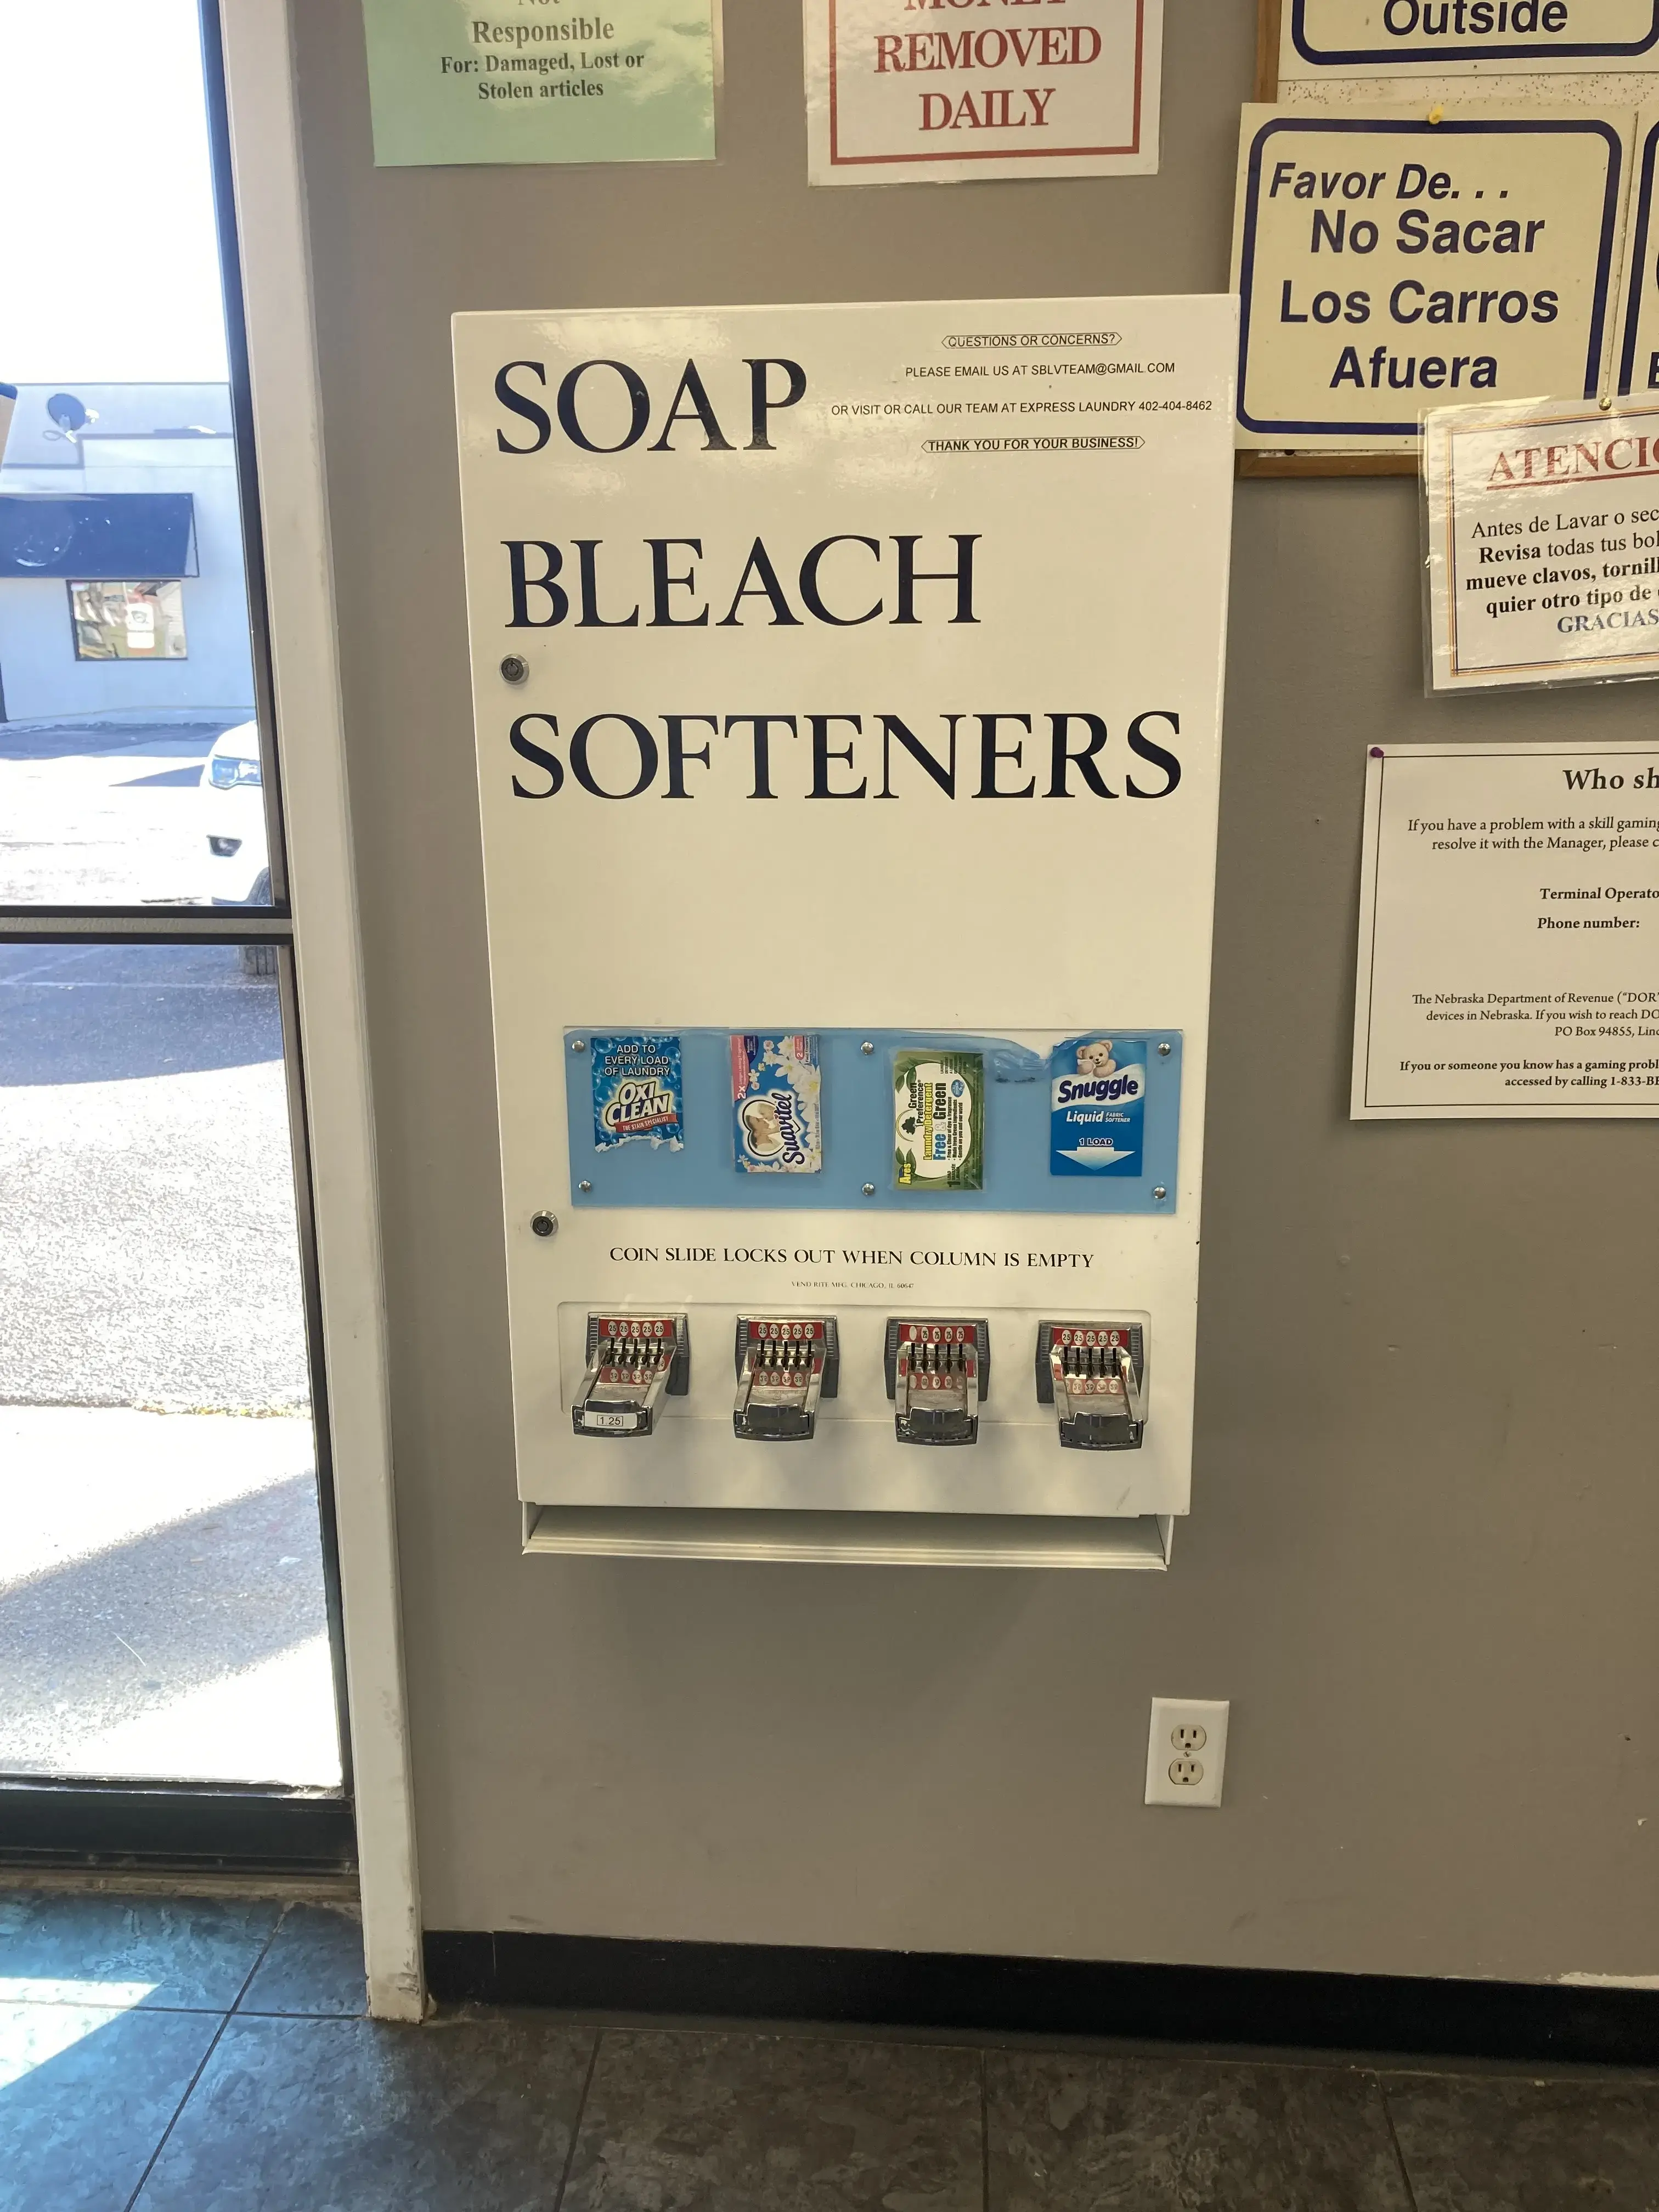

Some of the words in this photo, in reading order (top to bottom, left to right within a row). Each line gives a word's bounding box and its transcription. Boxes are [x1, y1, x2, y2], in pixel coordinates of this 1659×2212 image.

[1384, 0, 1568, 35] Outside
[473, 17, 614, 48] Responsible
[873, 26, 1101, 73] REMOVED
[441, 57, 478, 73] For:
[486, 53, 574, 75] Damaged,
[581, 52, 619, 69] Lost
[625, 55, 644, 67] or
[479, 82, 533, 99] Stolen
[540, 80, 603, 97] articles
[918, 88, 1056, 131] DAILY
[1269, 163, 1385, 199] Favor
[1311, 209, 1380, 254] No
[1396, 209, 1545, 254] Sacar
[1280, 280, 1371, 324] Los
[1390, 280, 1559, 324] Carros
[948, 335, 1017, 348] QUESTIONS
[1020, 335, 1038, 346] OR
[1041, 332, 1116, 346] CONCERNS?
[906, 366, 951, 377] PLEASE
[955, 366, 989, 376] EMAIL
[994, 365, 1008, 375] US
[1012, 365, 1028, 375] AT
[1031, 363, 1175, 375] SBLVTEAM@GMAIL.COM
[1330, 346, 1498, 388] Afuera
[495, 357, 807, 454] SOAP
[832, 405, 849, 415] OR
[851, 405, 881, 415] VISIT
[884, 404, 901, 414] OR
[904, 404, 933, 414] CALL
[936, 404, 962, 414] OUR
[966, 403, 997, 413] TEAM
[1001, 403, 1017, 413] AT
[1020, 402, 1075, 413] EXPRESS
[1079, 402, 1136, 411] LAUNDRY
[1139, 400, 1211, 411] 402-404-8462
[928, 441, 969, 451] THANK
[974, 439, 1001, 450] YOU
[1004, 439, 1029, 450] FOR
[1034, 438, 1068, 449] YOUR
[1071, 437, 1138, 449] BUSINESS!
[1488, 437, 1659, 481] ATENCI
[1471, 522, 1522, 538] Antes
[1529, 516, 1549, 533] de
[1555, 514, 1609, 531] Lavar
[1614, 513, 1624, 524] o
[1479, 544, 1542, 563] Revisa
[1547, 538, 1594, 557] todas
[1601, 538, 1626, 552] tus
[501, 534, 983, 628] BLEACH
[1466, 574, 1527, 590] mueve
[1533, 567, 1596, 584] clavos,
[1486, 596, 1536, 618] quier
[1542, 594, 1580, 609] otro
[1586, 588, 1623, 610] tipo
[1629, 584, 1651, 601] de
[509, 710, 1182, 801] SOFTENERS
[1562, 768, 1624, 790] Who
[1408, 819, 1420, 831] If
[1420, 823, 1444, 834] you
[1447, 819, 1476, 830] have
[1489, 817, 1544, 834] problem
[1547, 817, 1575, 829] with
[1589, 816, 1613, 828] skill
[1432, 837, 1476, 850] resolve
[1480, 838, 1489, 849] it
[1492, 837, 1520, 849] with
[1524, 837, 1543, 849] the
[1547, 837, 1606, 852] Manager,
[1609, 835, 1649, 851] please
[1539, 887, 1601, 899] Terminal
[1537, 917, 1580, 928] Phone
[1583, 916, 1639, 928] number:
[1412, 994, 1432, 1004] The
[1435, 993, 1484, 1003] Nebraska
[1487, 994, 1553, 1007] Department
[1555, 992, 1567, 1003] of
[1567, 992, 1614, 1003] Revenue
[1426, 1010, 1464, 1020] devices
[1467, 1011, 1477, 1020] in
[1480, 1009, 1532, 1020] Nebraska.
[1536, 1010, 1546, 1020] If
[1545, 1013, 1566, 1023] you
[1568, 1009, 1593, 1019] wish
[1609, 1009, 1638, 1019] reach
[1555, 1026, 1572, 1036] PO
[1575, 1026, 1596, 1036] Box
[1599, 1026, 1634, 1038] 94855,
[605, 1056, 637, 1064] EVERY
[641, 1056, 669, 1064] LOAD
[617, 1045, 639, 1053] ADD
[641, 1045, 656, 1053] TO
[605, 1067, 619, 1076] OF
[621, 1067, 670, 1076] LAUNDRY
[1400, 1060, 1410, 1070] If
[1411, 1064, 1431, 1073] you
[1500, 1063, 1520, 1072] you
[1523, 1059, 1554, 1069] know
[1555, 1059, 1574, 1069] has
[1585, 1060, 1626, 1072] gaming
[619, 1081, 656, 1105] OXI
[1058, 1075, 1138, 1103] Snuggle
[1505, 1076, 1552, 1086] accessed
[1555, 1076, 1568, 1088] by
[1571, 1076, 1607, 1088] calling
[908, 1082, 917, 1109] Green
[923, 1082, 933, 1126] Detergent
[933, 1082, 946, 1120] Green
[607, 1094, 670, 1126] CLEAN
[645, 1116, 669, 1127] SPECIALIST
[1066, 1110, 1104, 1125] Liquid
[771, 1092, 805, 1165] Suavitel
[934, 1122, 946, 1132] &
[923, 1126, 933, 1161] Laundry
[933, 1133, 946, 1160] Free
[898, 1162, 912, 1185] Ares
[610, 1248, 659, 1261] COIN
[666, 1248, 716, 1261] SLIDE
[723, 1249, 787, 1262] LOCKS
[794, 1250, 835, 1263] OUT
[842, 1250, 903, 1264] WHEN
[910, 1251, 996, 1266] COLUMN
[1004, 1253, 1019, 1266] IS
[1028, 1254, 1094, 1267] EMPTY
[600, 1417, 620, 1425] 1.25
